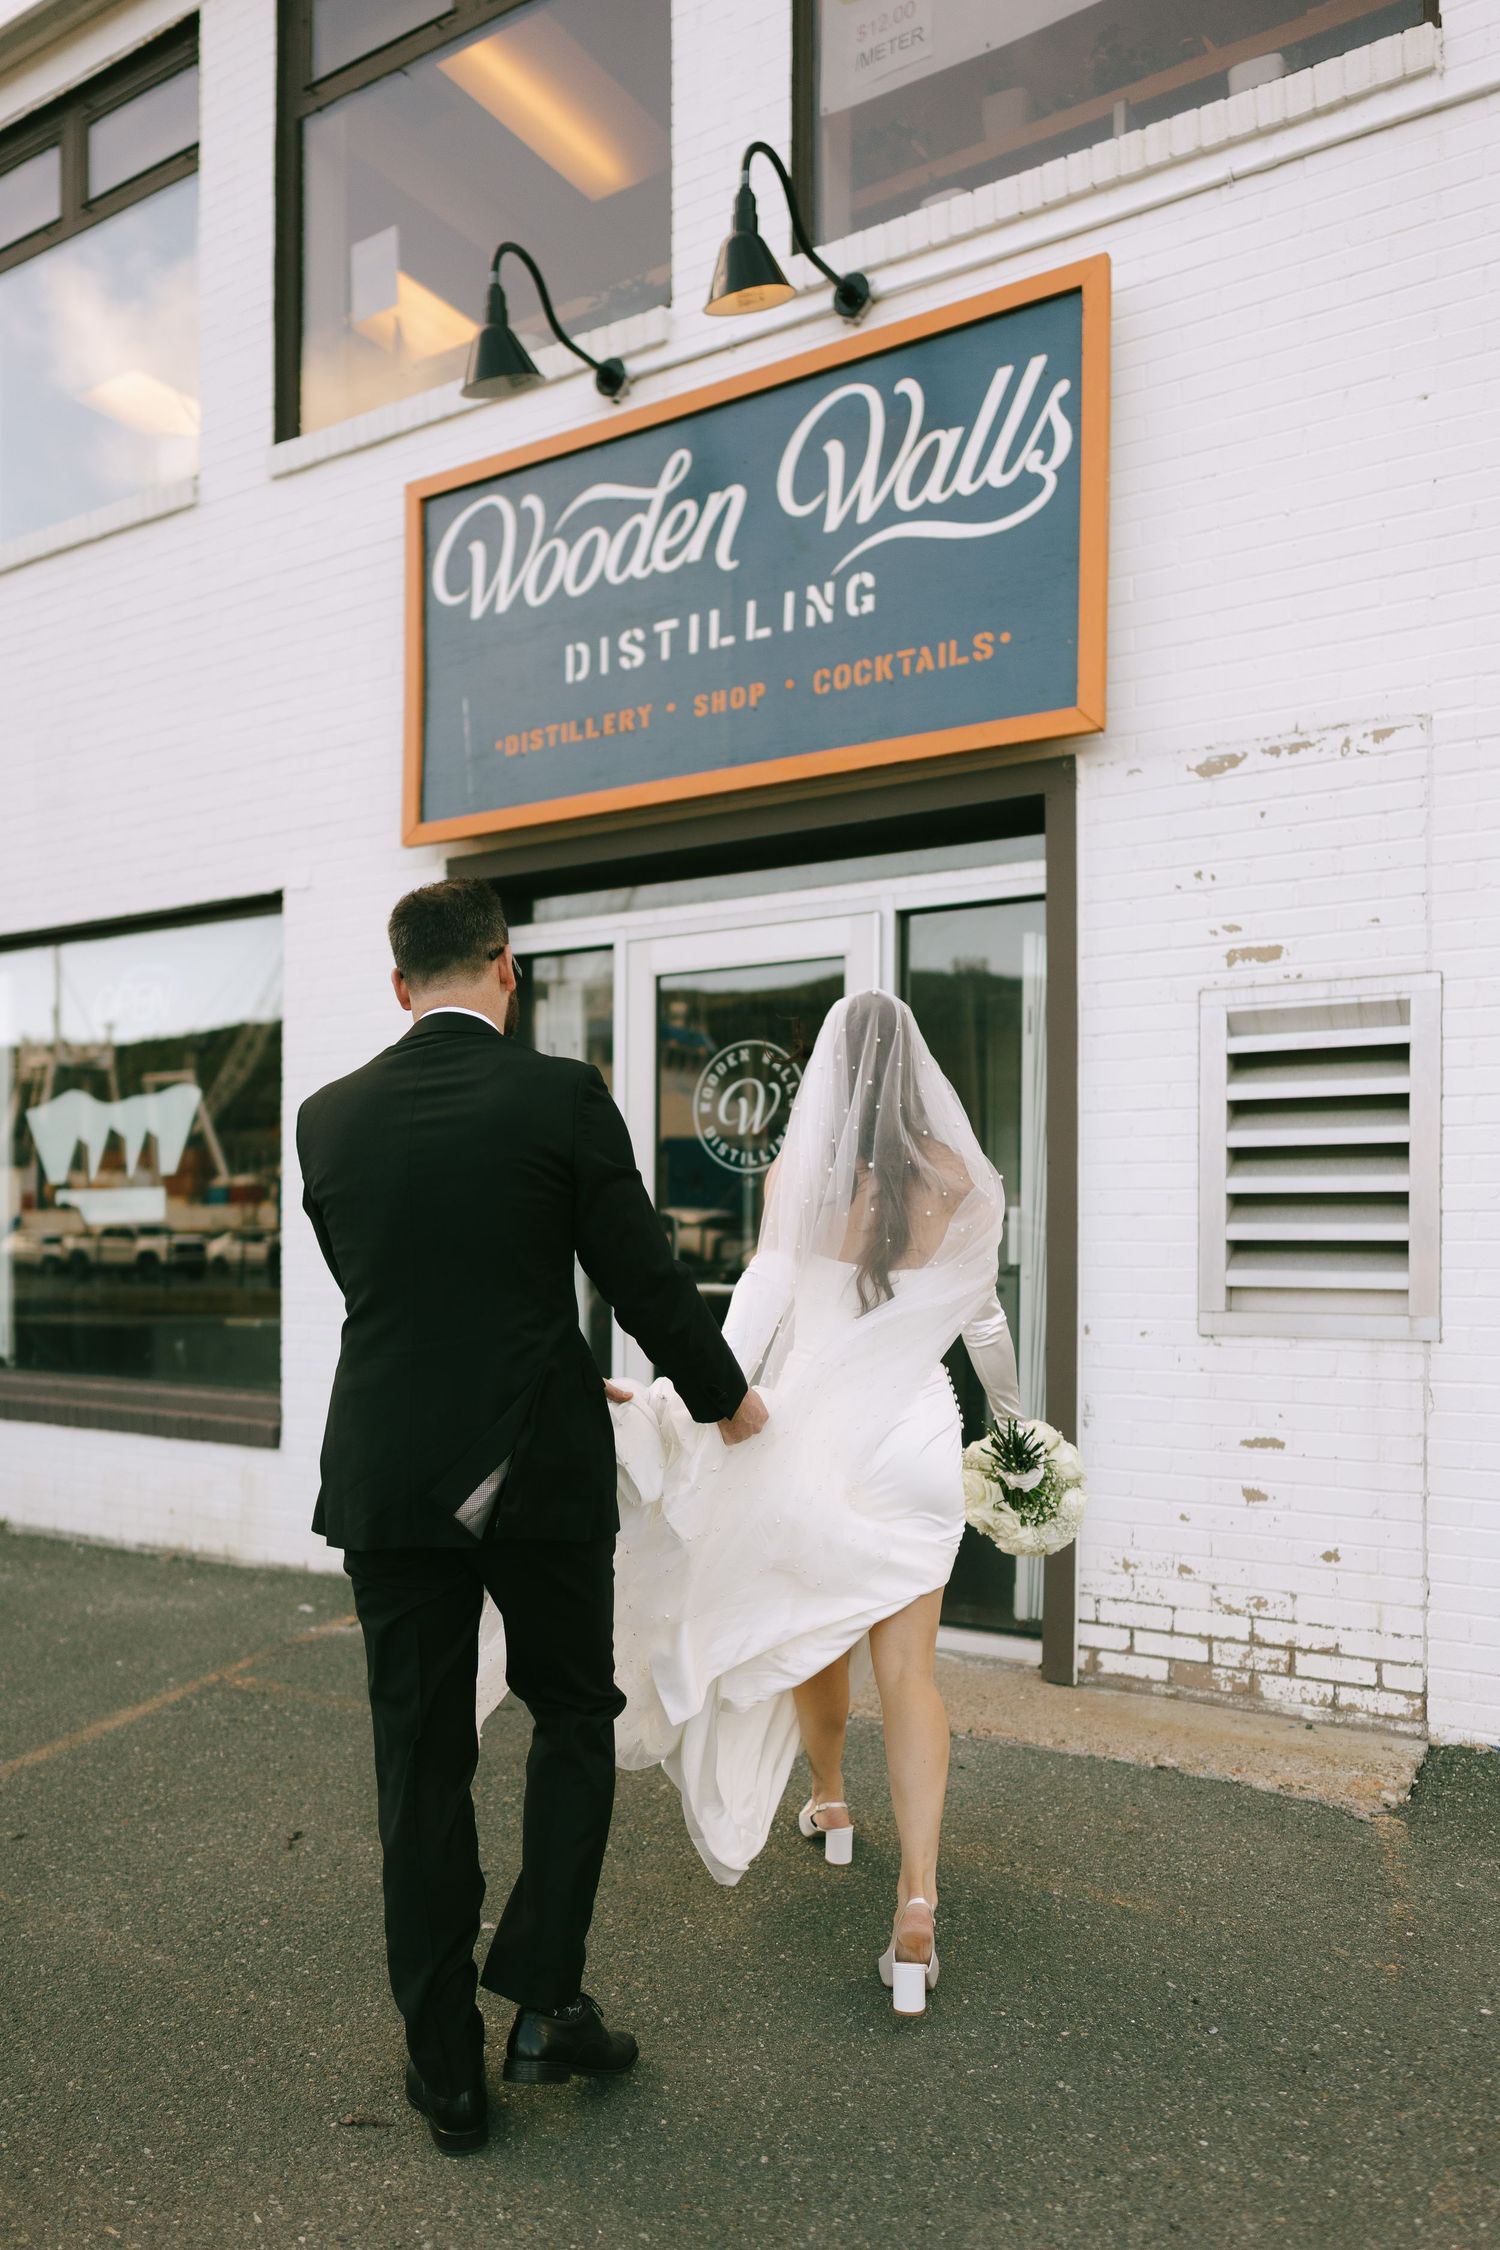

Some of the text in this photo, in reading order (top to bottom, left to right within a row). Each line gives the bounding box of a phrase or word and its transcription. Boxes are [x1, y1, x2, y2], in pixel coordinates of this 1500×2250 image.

[432, 353, 1073, 620] Wooden Walls
[564, 571, 876, 684] DISTILLING
[505, 631, 995, 757] DISTILLERY SHOP COCKTAILS
[718, 1077, 782, 1136] W
